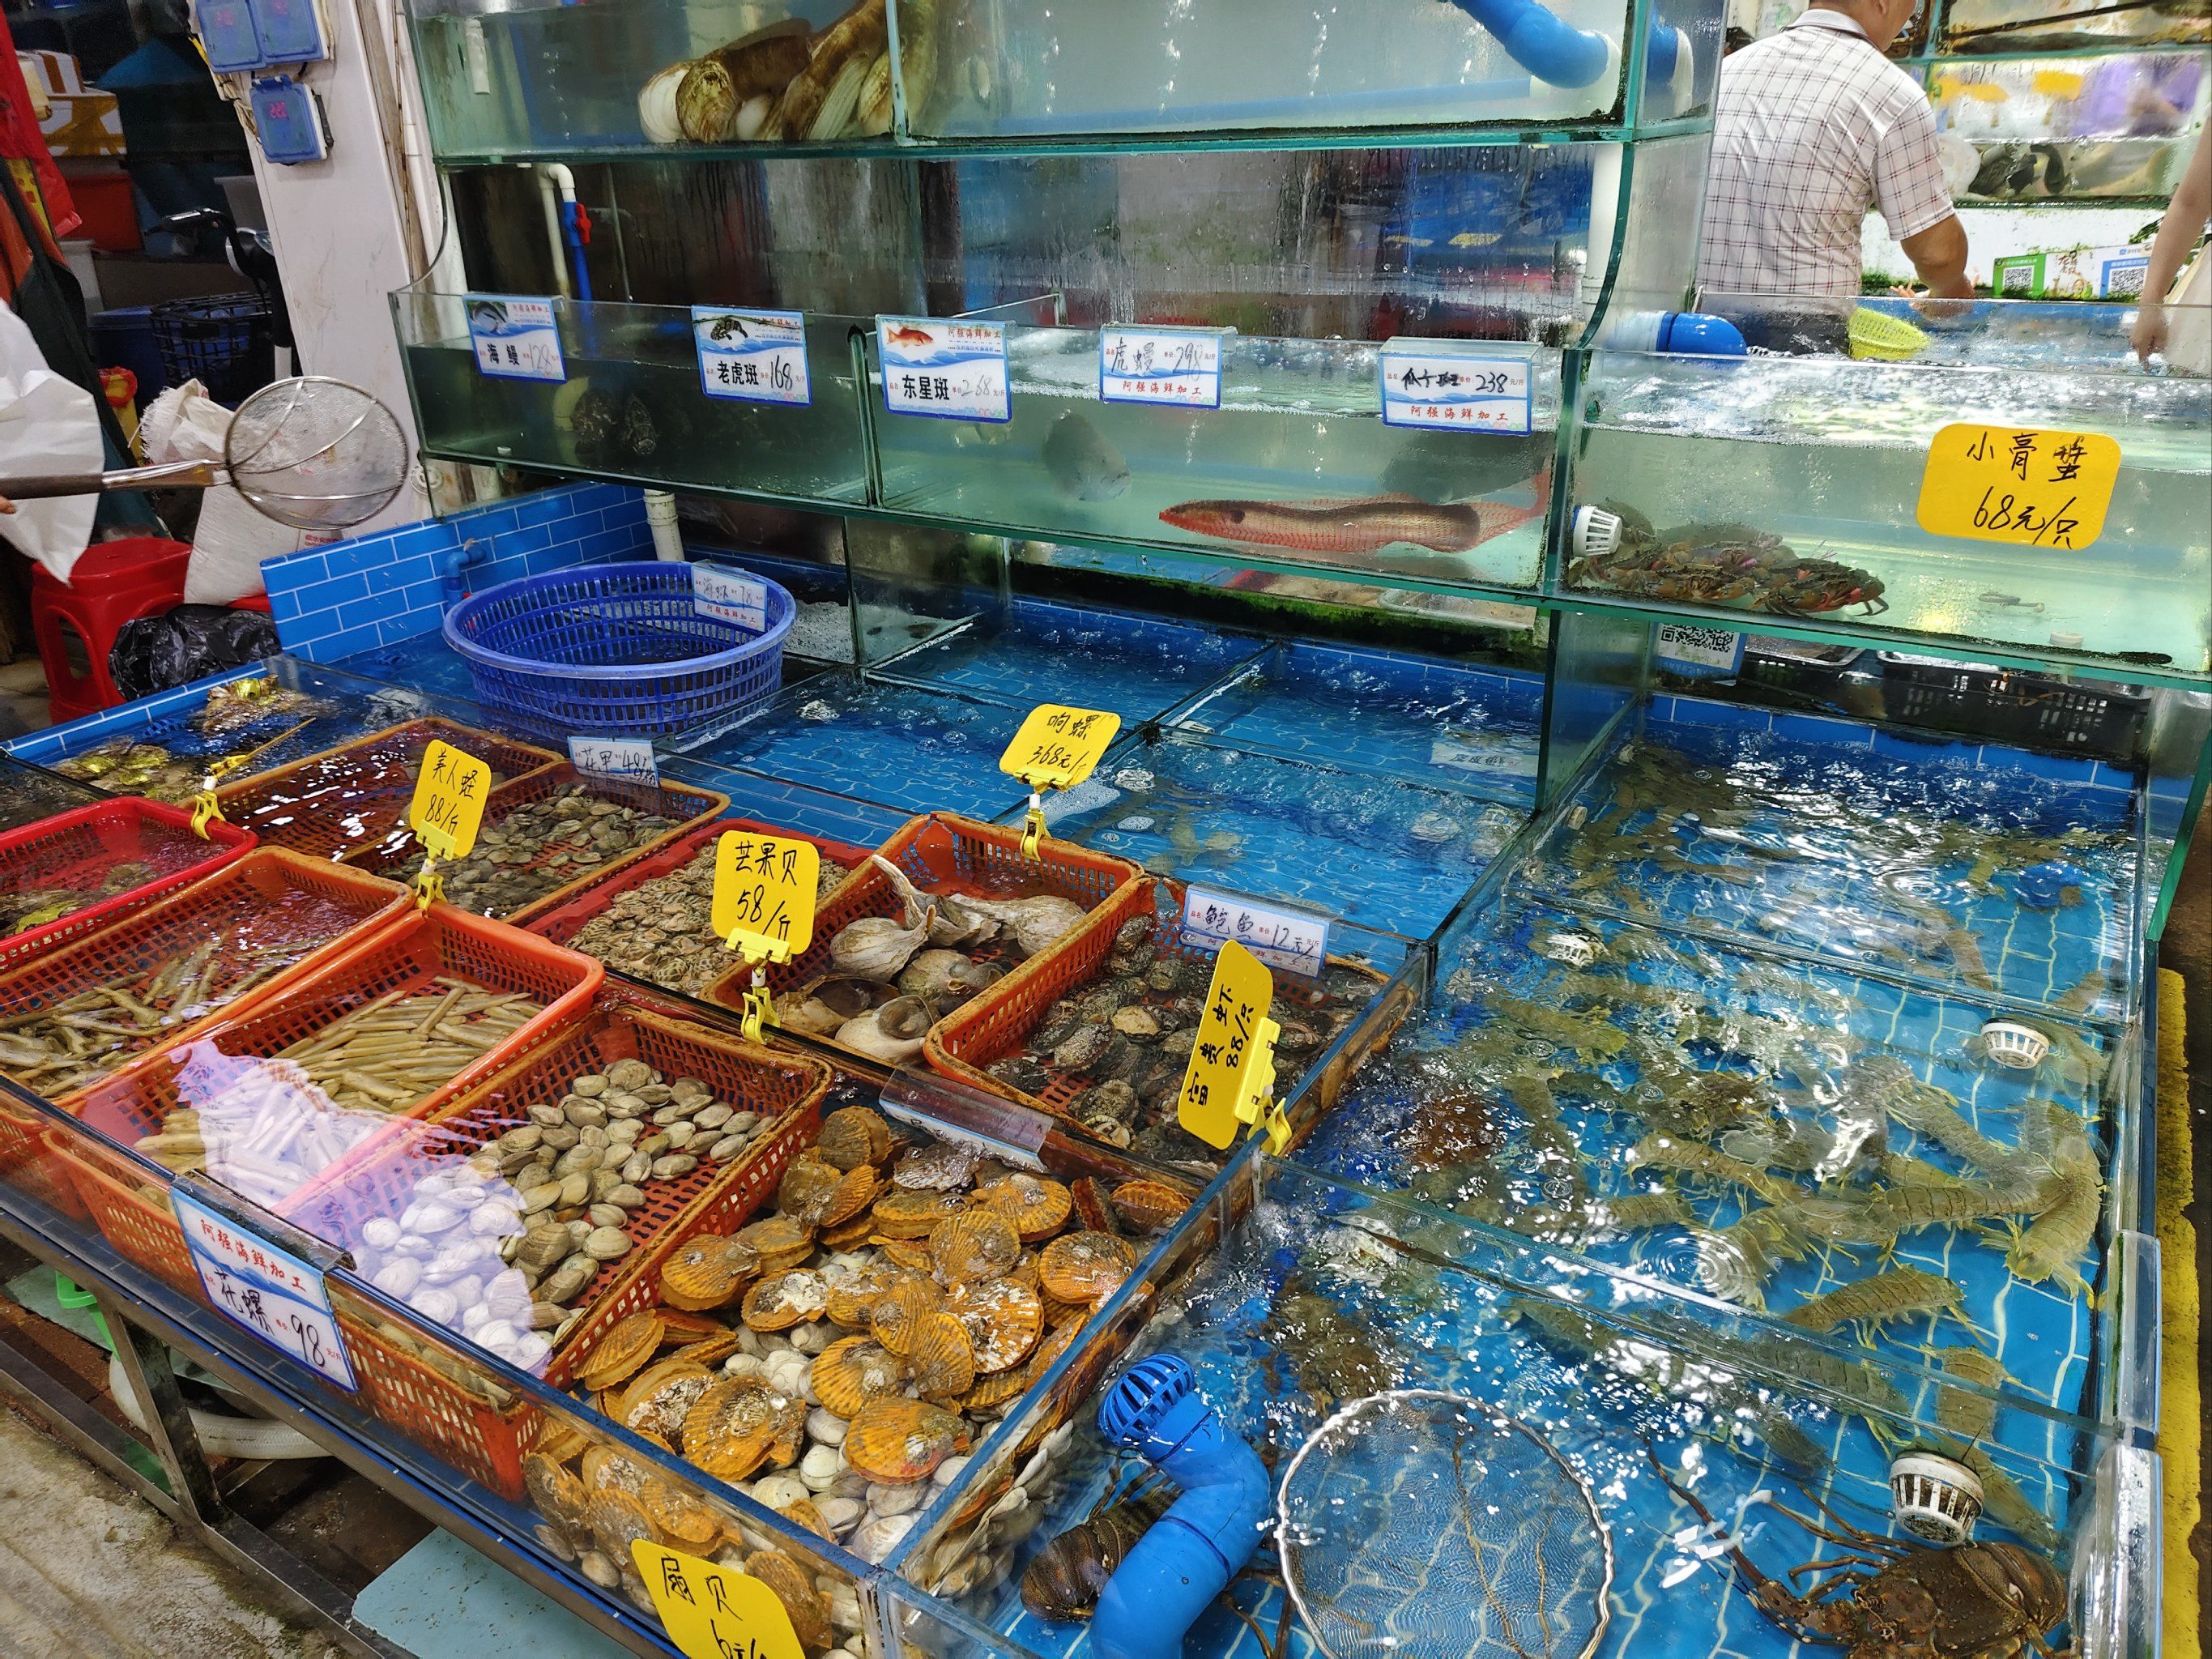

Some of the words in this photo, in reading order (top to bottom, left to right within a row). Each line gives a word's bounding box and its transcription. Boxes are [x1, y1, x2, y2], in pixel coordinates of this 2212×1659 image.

[488, 343, 520, 365] 海鳗
[717, 360, 759, 385] 老虎斑
[770, 355, 793, 390] 168
[902, 374, 949, 400] 东星斑
[1123, 381, 1202, 395] 阿强海鲜加工
[1475, 371, 1508, 393] 238
[1410, 405, 1509, 421] 阿强海鲜加工
[1966, 431, 2088, 482] 小膏蟹
[1973, 485, 2078, 550] 68元/只
[581, 746, 612, 775] 花甲
[424, 794, 458, 837] 88/斤
[735, 840, 798, 885] 芒果贝
[738, 884, 791, 941] 58/斤
[1225, 1002, 1255, 1068] 88/只
[201, 1218, 306, 1293] 阿强海鲜加工
[291, 1314, 326, 1367] 98
